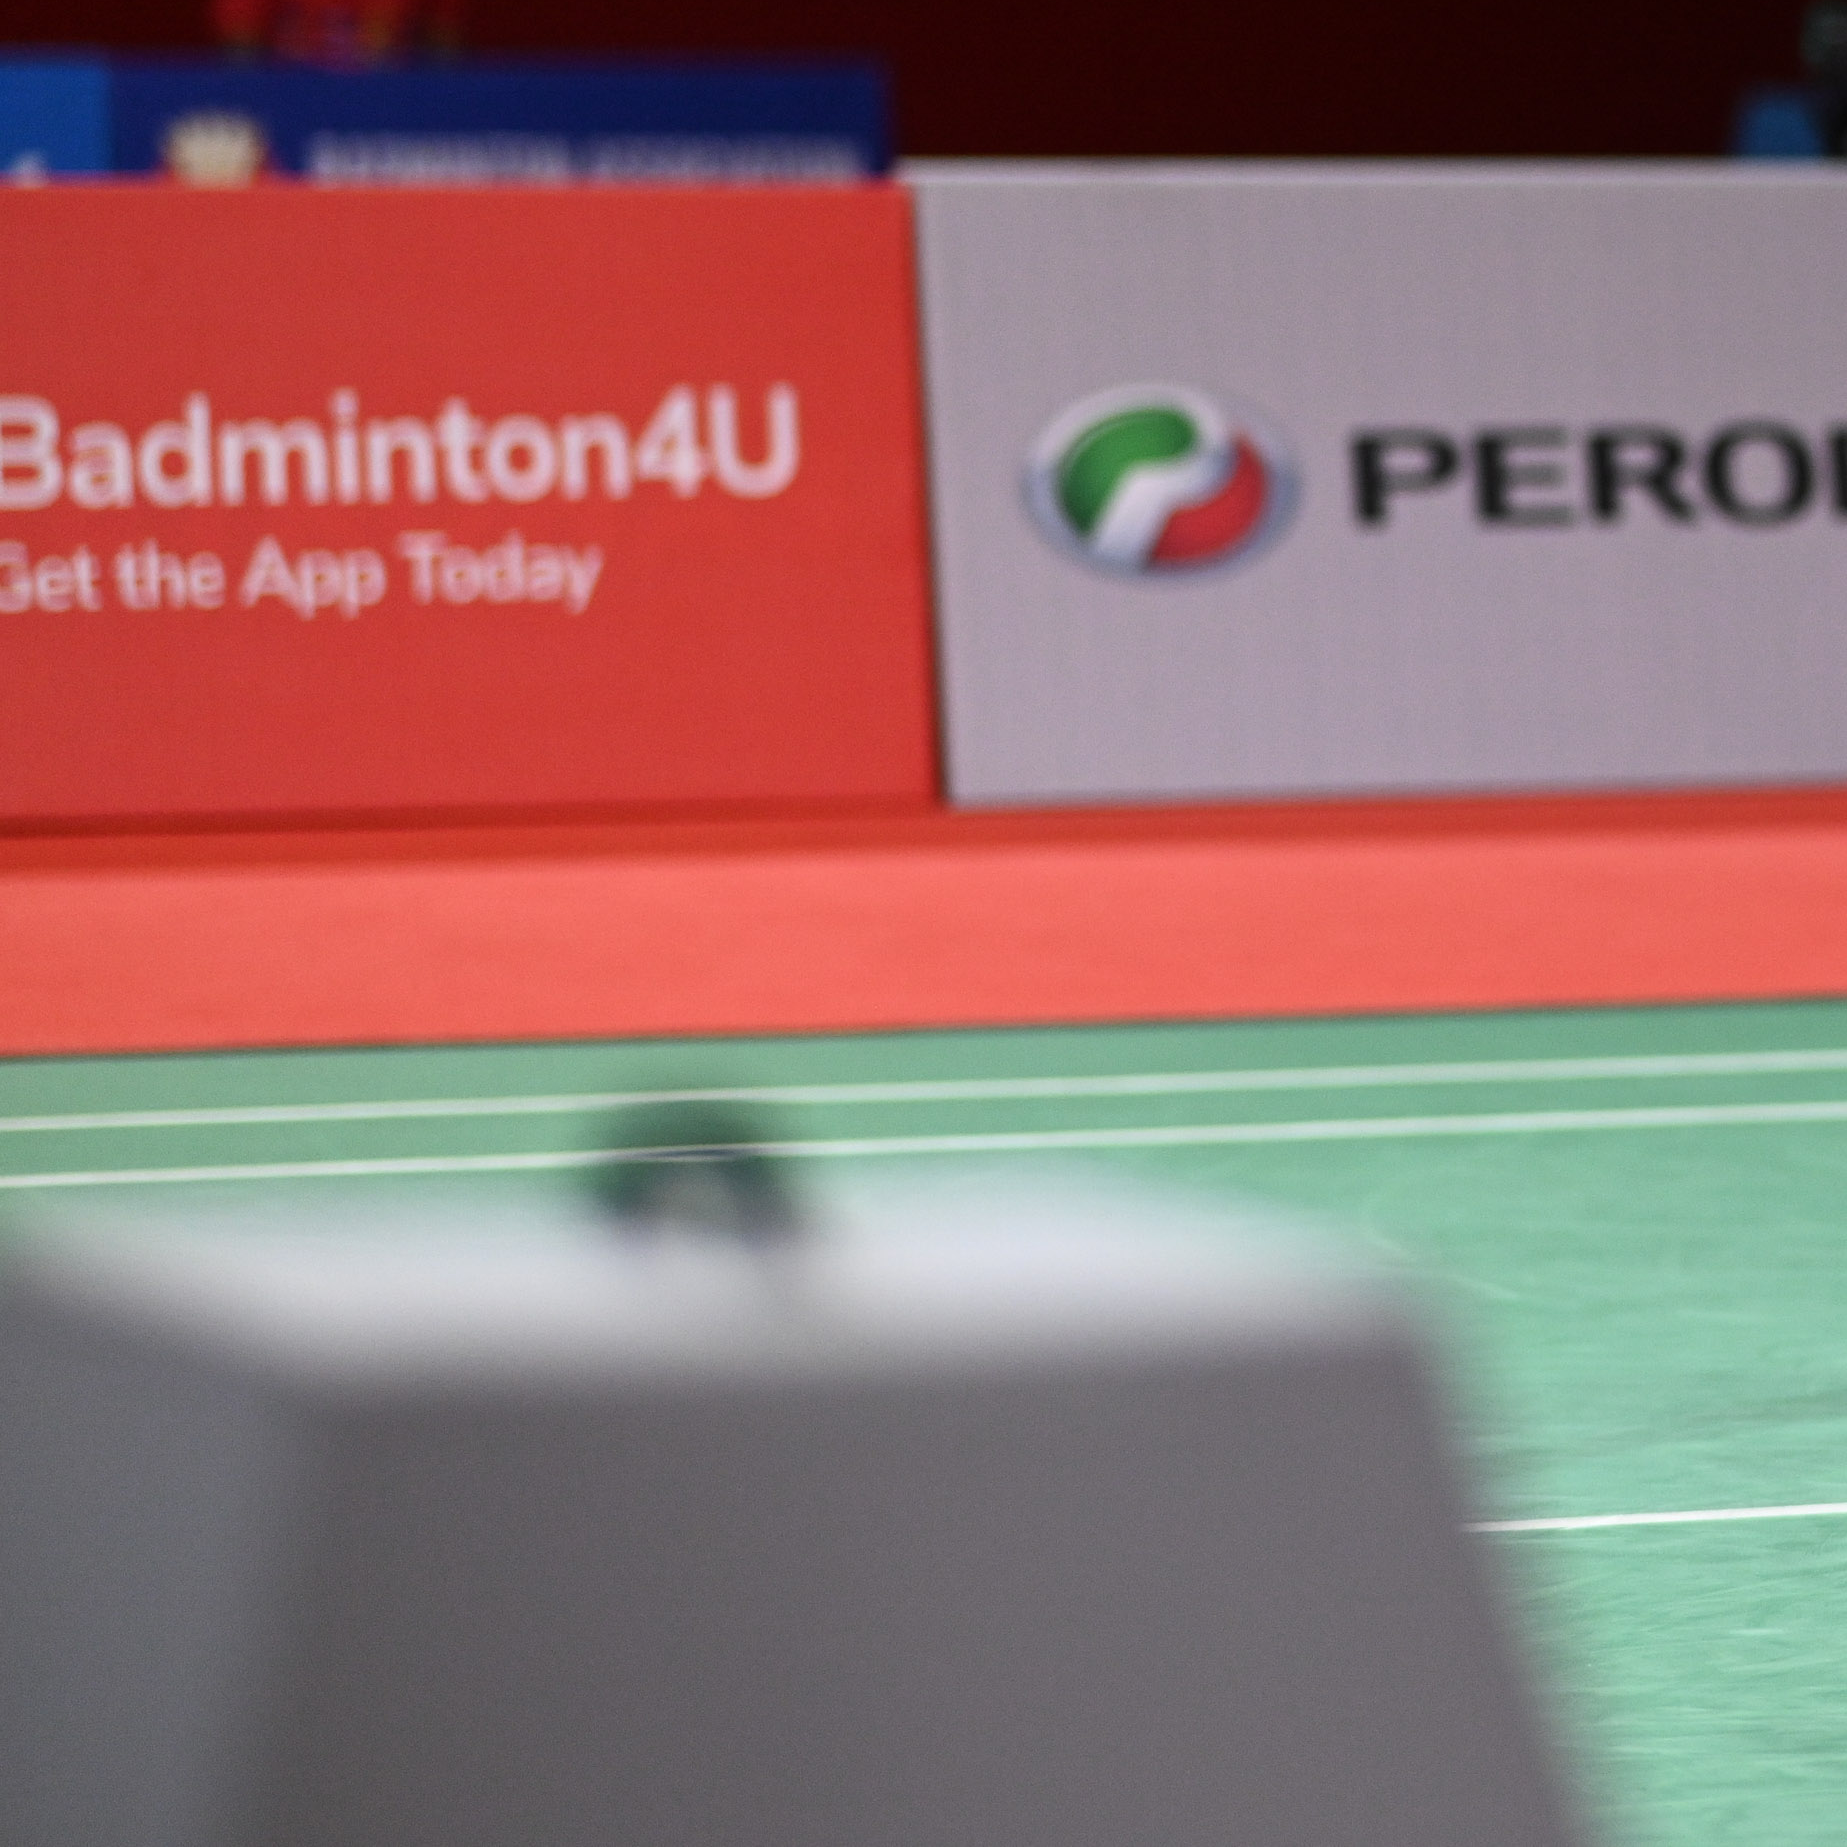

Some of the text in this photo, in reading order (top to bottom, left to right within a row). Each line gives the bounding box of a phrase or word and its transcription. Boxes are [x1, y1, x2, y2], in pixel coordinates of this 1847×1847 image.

[0, 383, 801, 510] Badminton4U
[0, 530, 604, 620] Get the App Today
